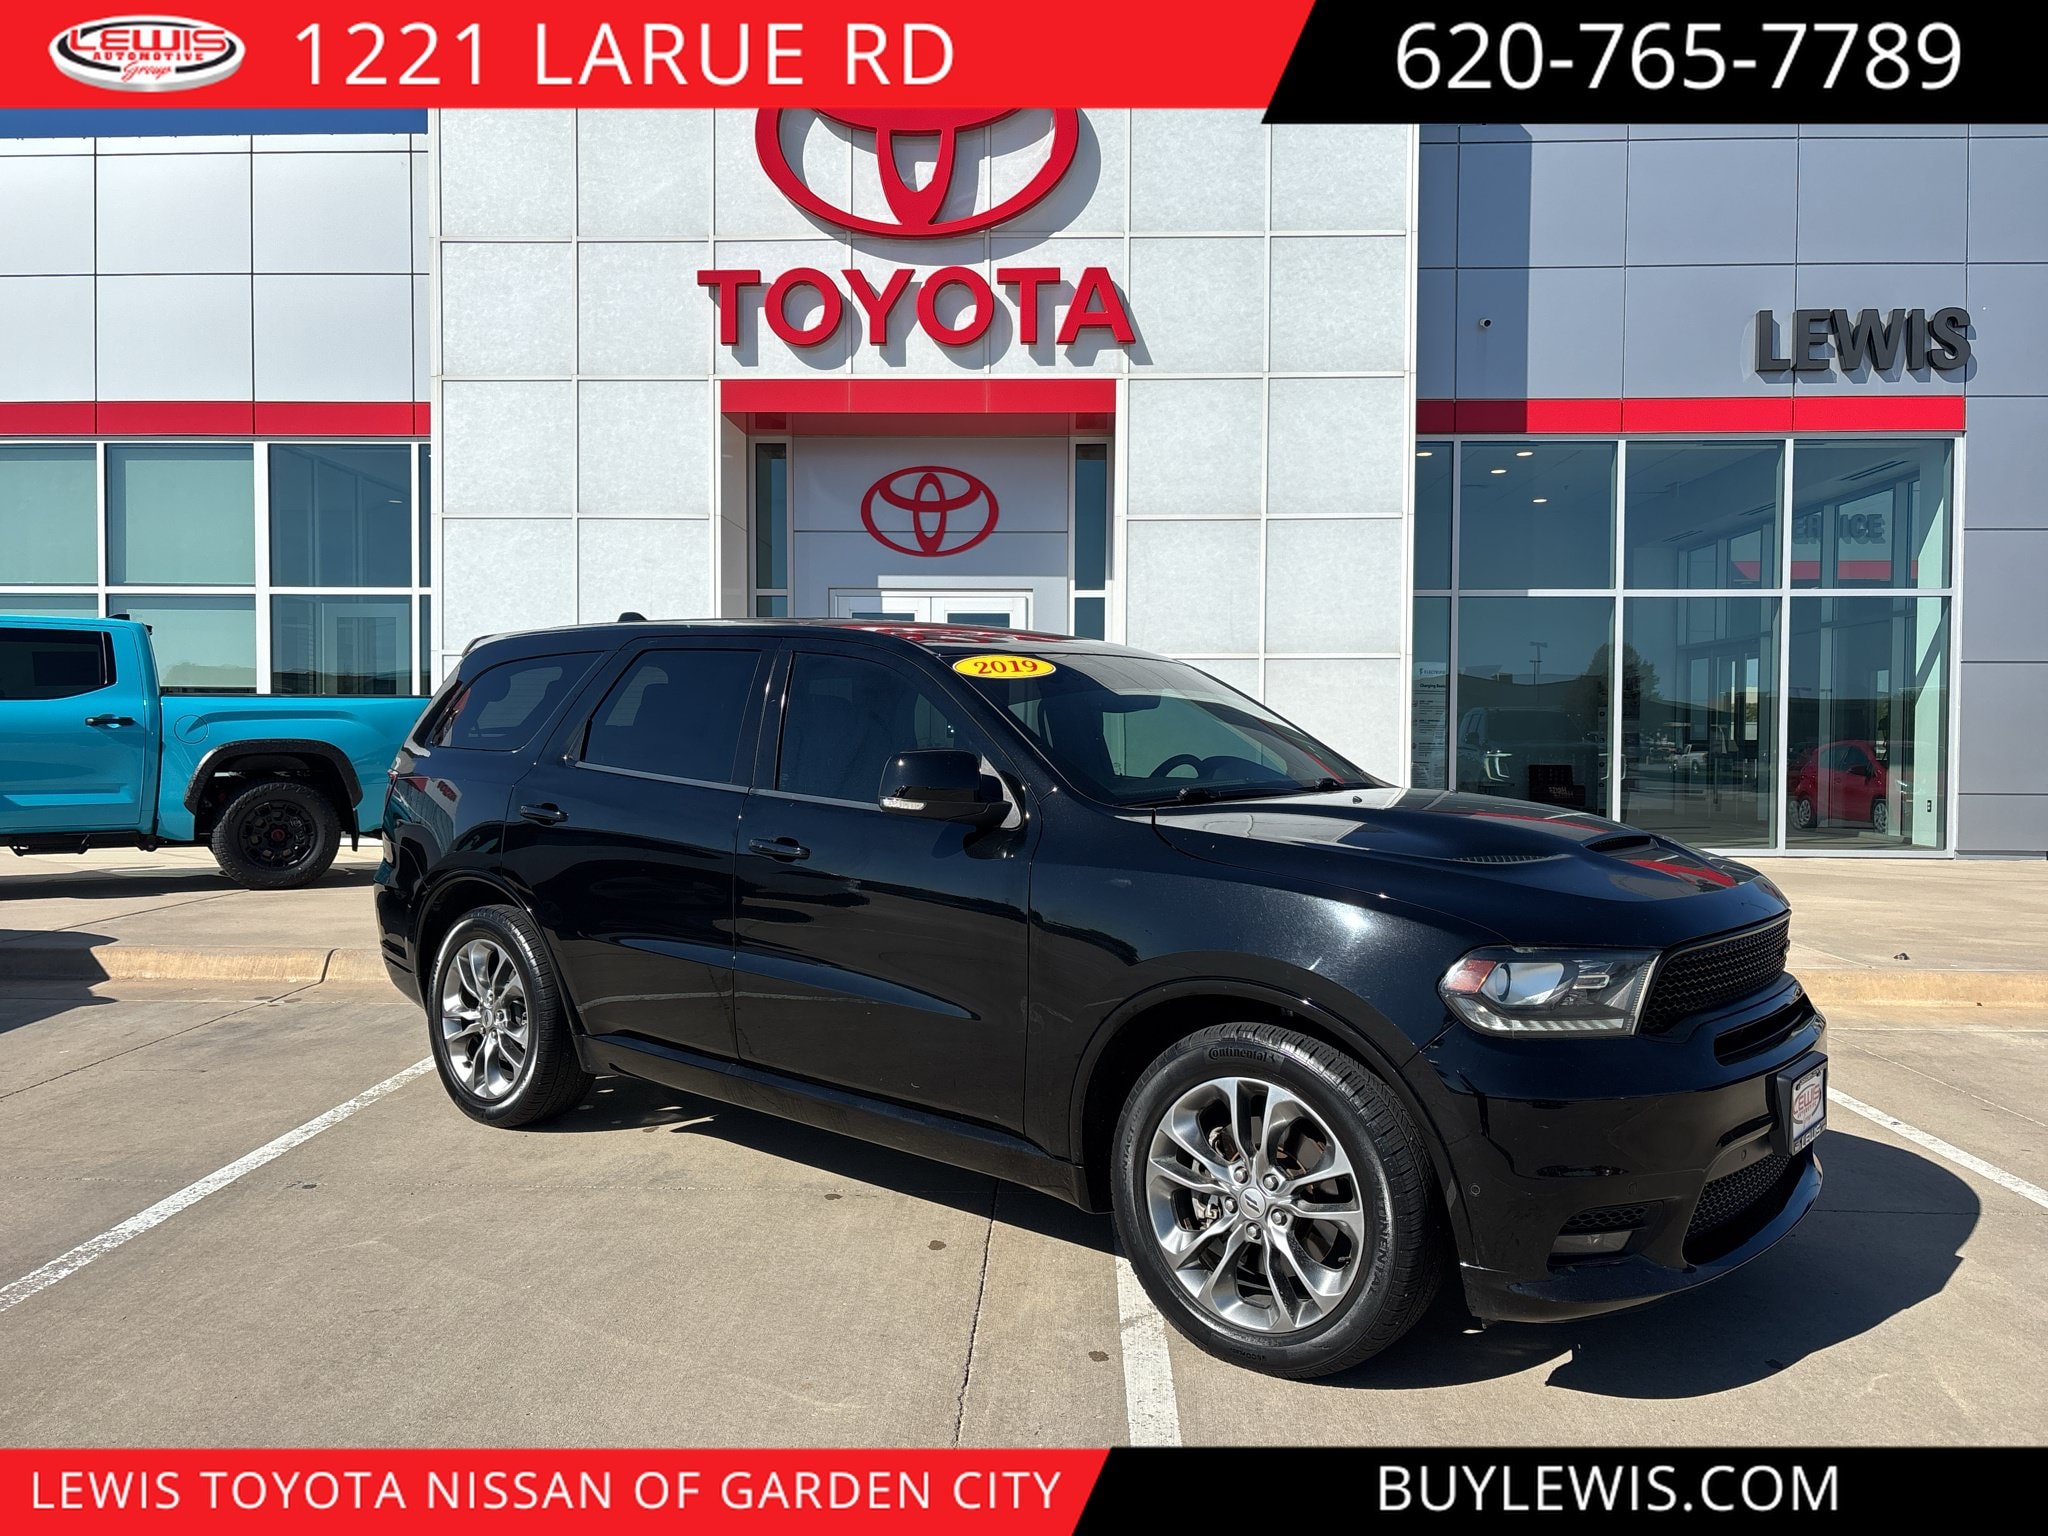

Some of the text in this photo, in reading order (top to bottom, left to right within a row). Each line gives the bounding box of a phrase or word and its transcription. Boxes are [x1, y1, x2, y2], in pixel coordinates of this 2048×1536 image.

[697, 266, 1137, 348] TOYOTA
[1755, 307, 1971, 371] LEWIS
[974, 659, 1038, 675] 2019
[1208, 1046, 1268, 1062] Continental
[1793, 1083, 1820, 1115] LEWIS
